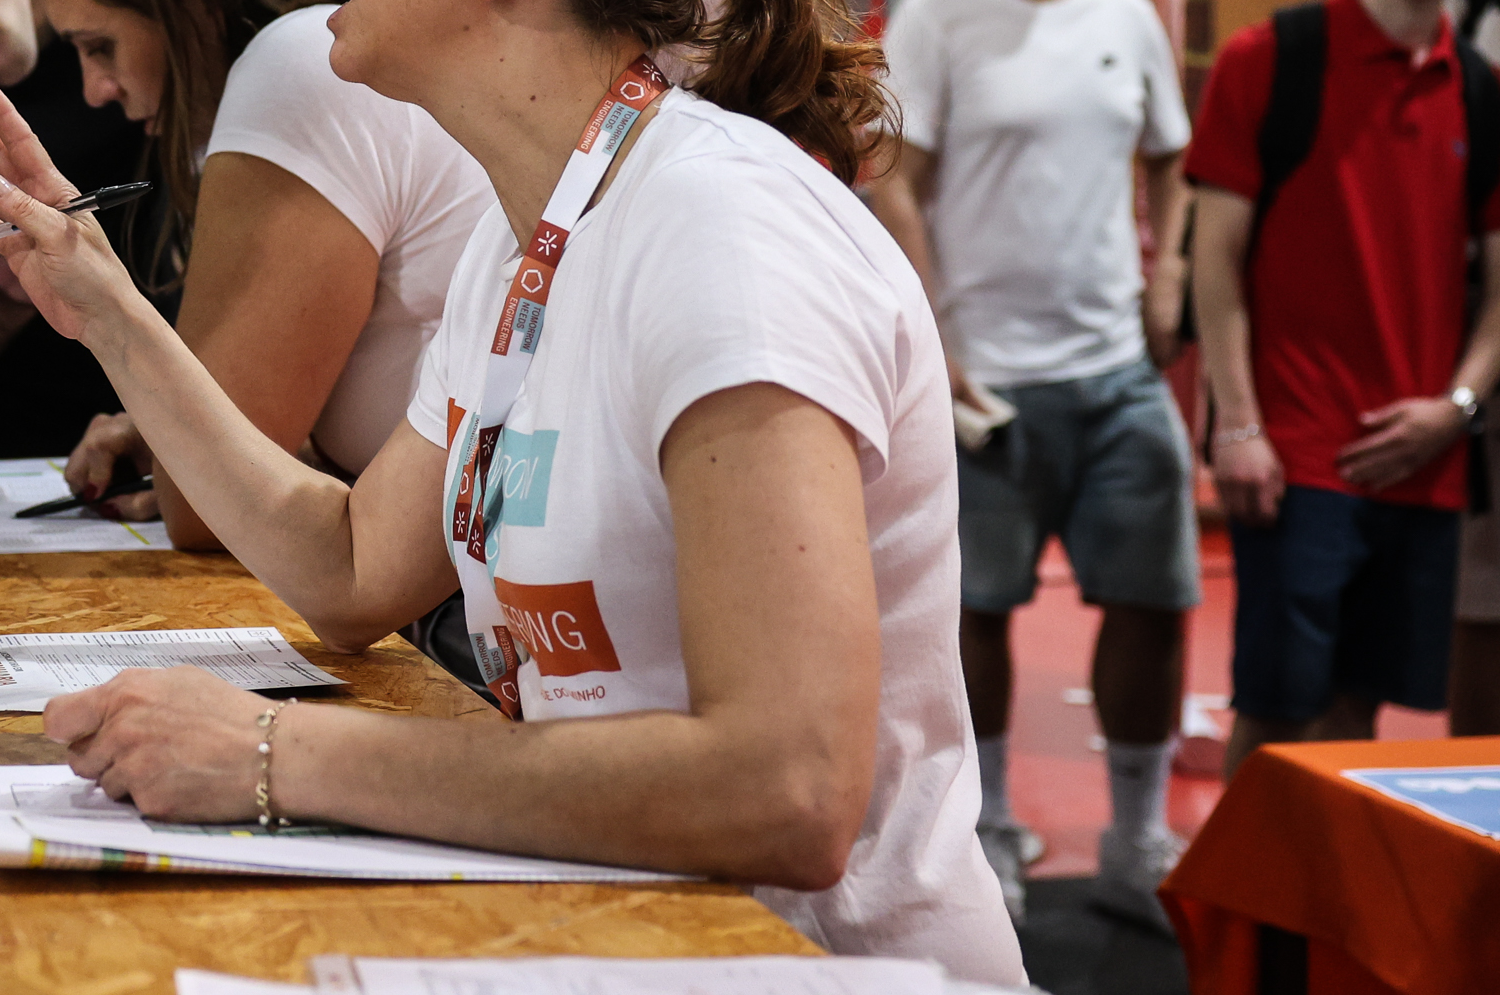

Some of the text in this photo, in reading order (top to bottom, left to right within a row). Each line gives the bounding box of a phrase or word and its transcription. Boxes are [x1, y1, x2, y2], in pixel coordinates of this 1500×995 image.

[580, 99, 614, 150] ENGINEERING
[605, 105, 625, 130] NEEDS
[606, 110, 636, 152] TOMORROW
[495, 297, 518, 352] ENGINEERING
[516, 301, 531, 330] NEEDS
[522, 306, 541, 351] TOMORROW
[476, 636, 494, 680] TOMORROW
